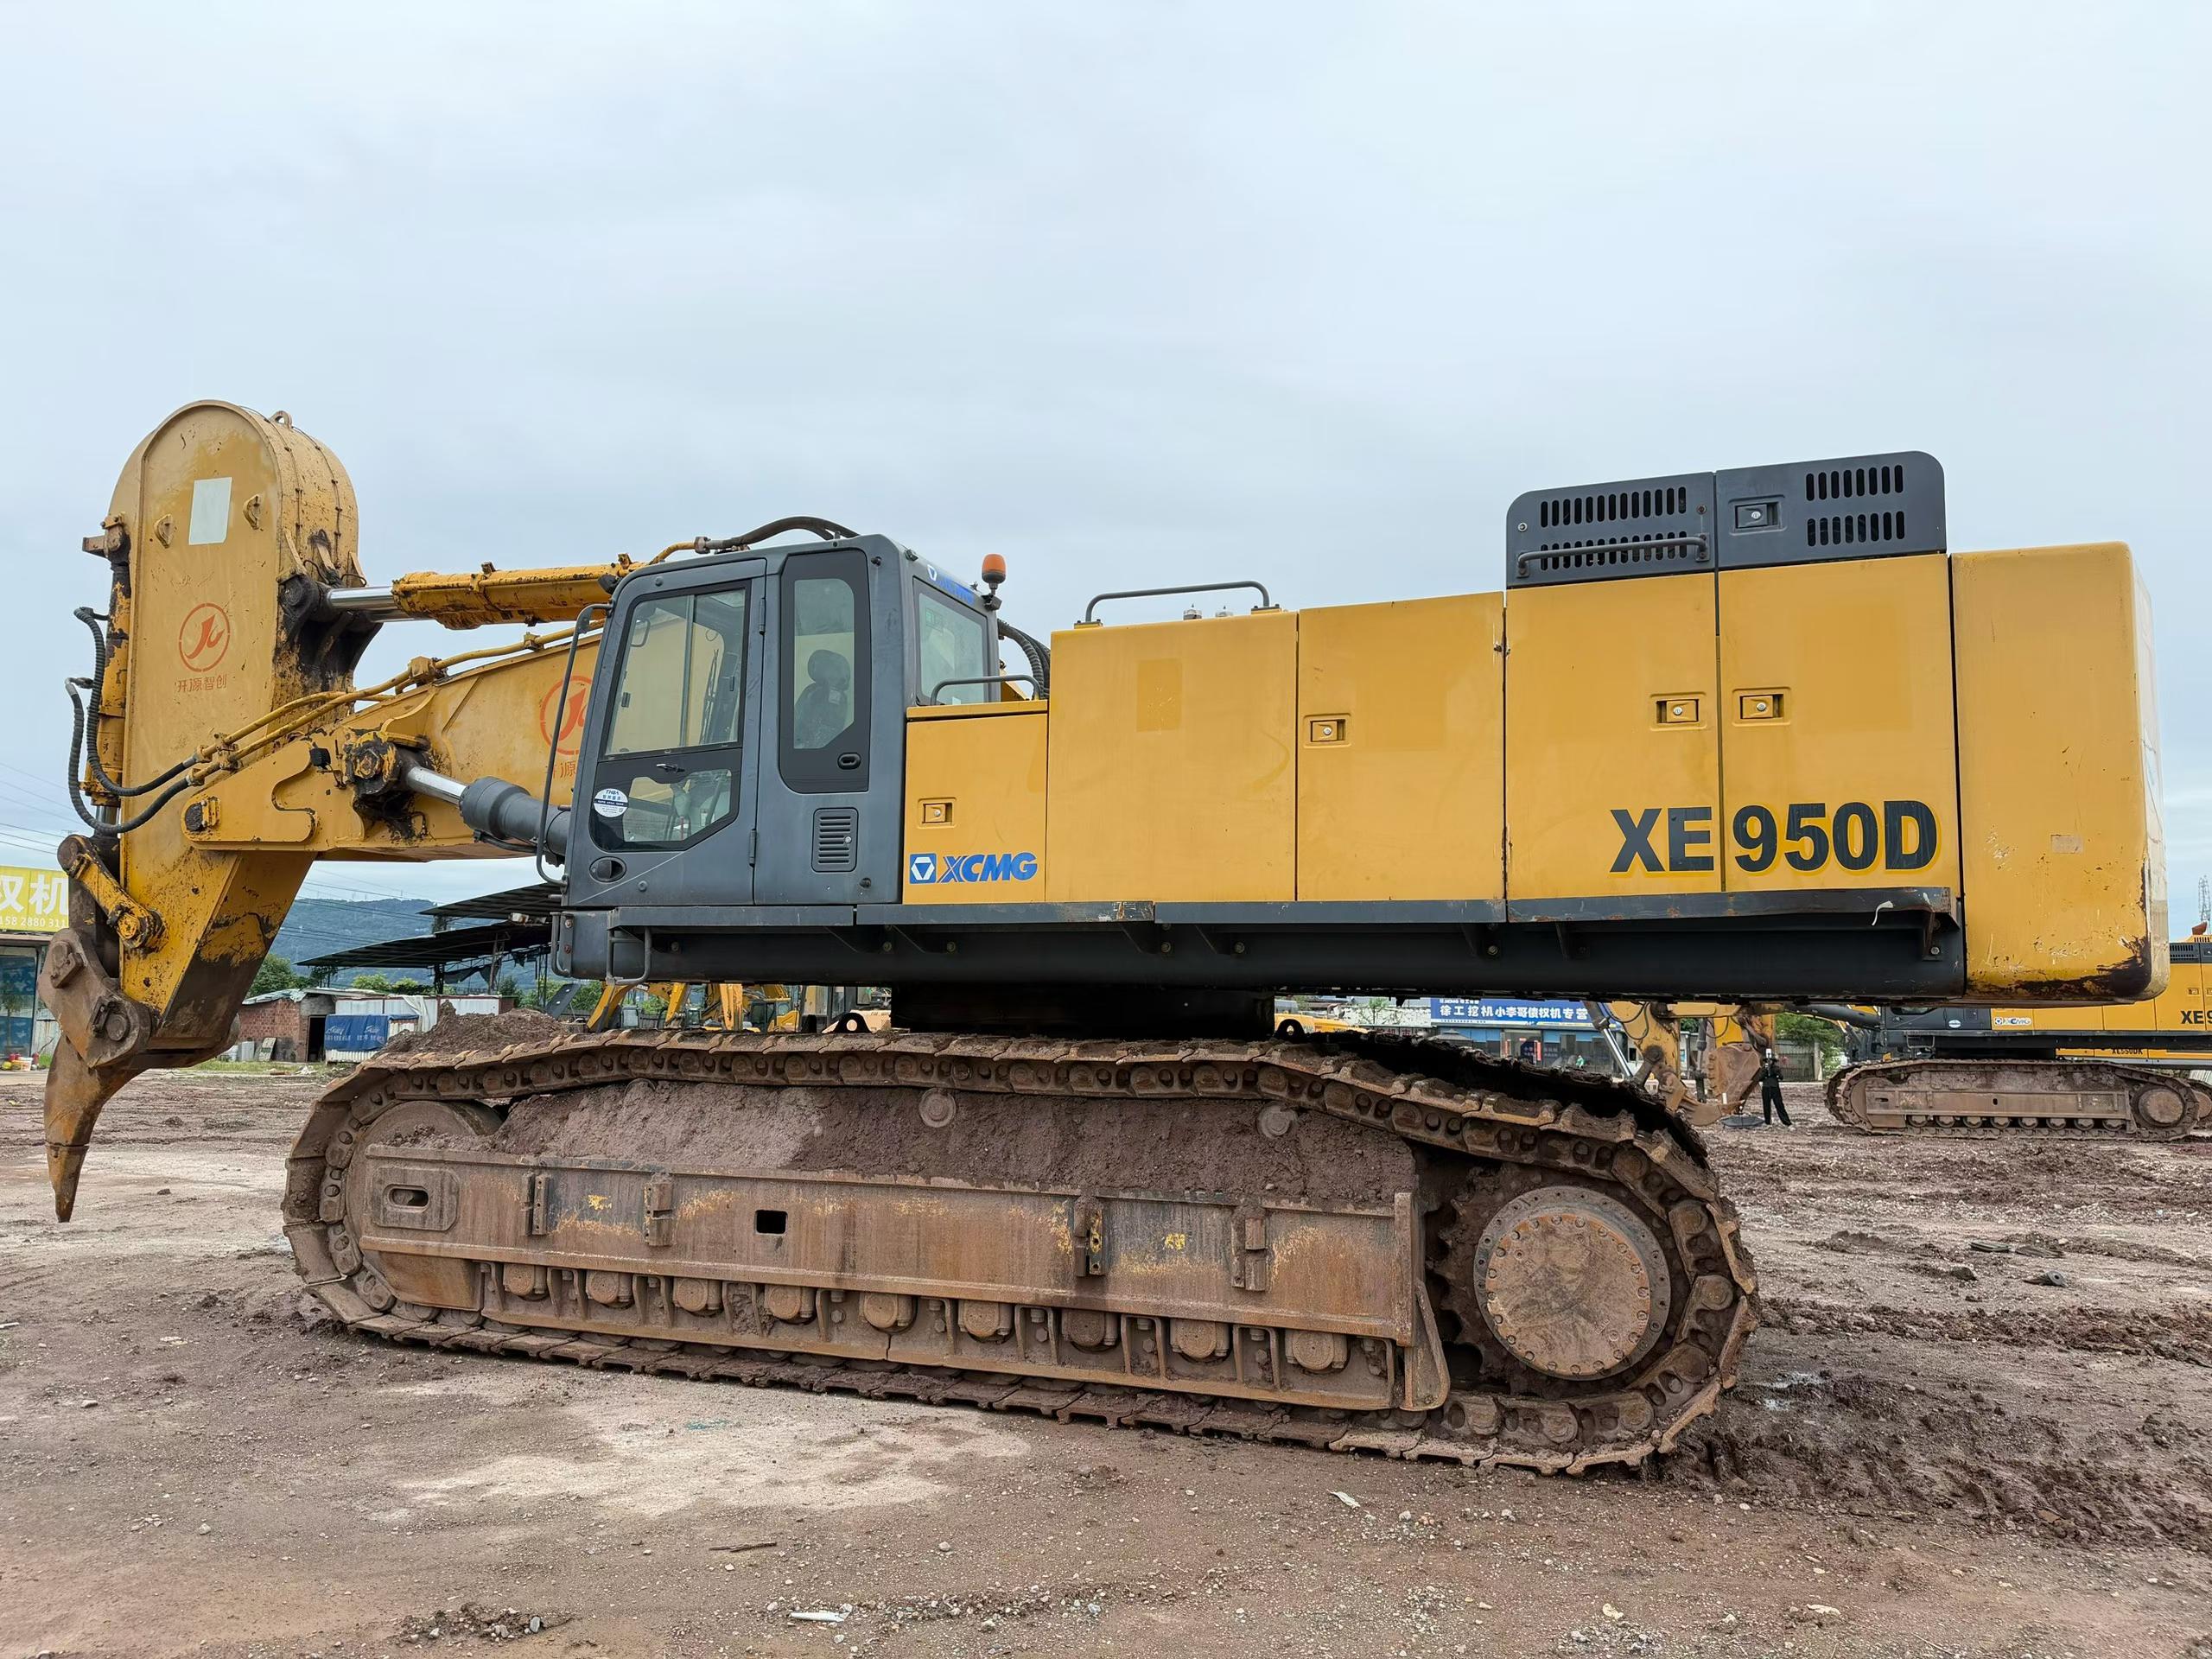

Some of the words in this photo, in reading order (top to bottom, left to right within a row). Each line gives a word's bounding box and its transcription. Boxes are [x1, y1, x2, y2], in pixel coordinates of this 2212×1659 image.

[178, 674, 227, 692] 开源智创
[937, 852, 1038, 884] XCMG
